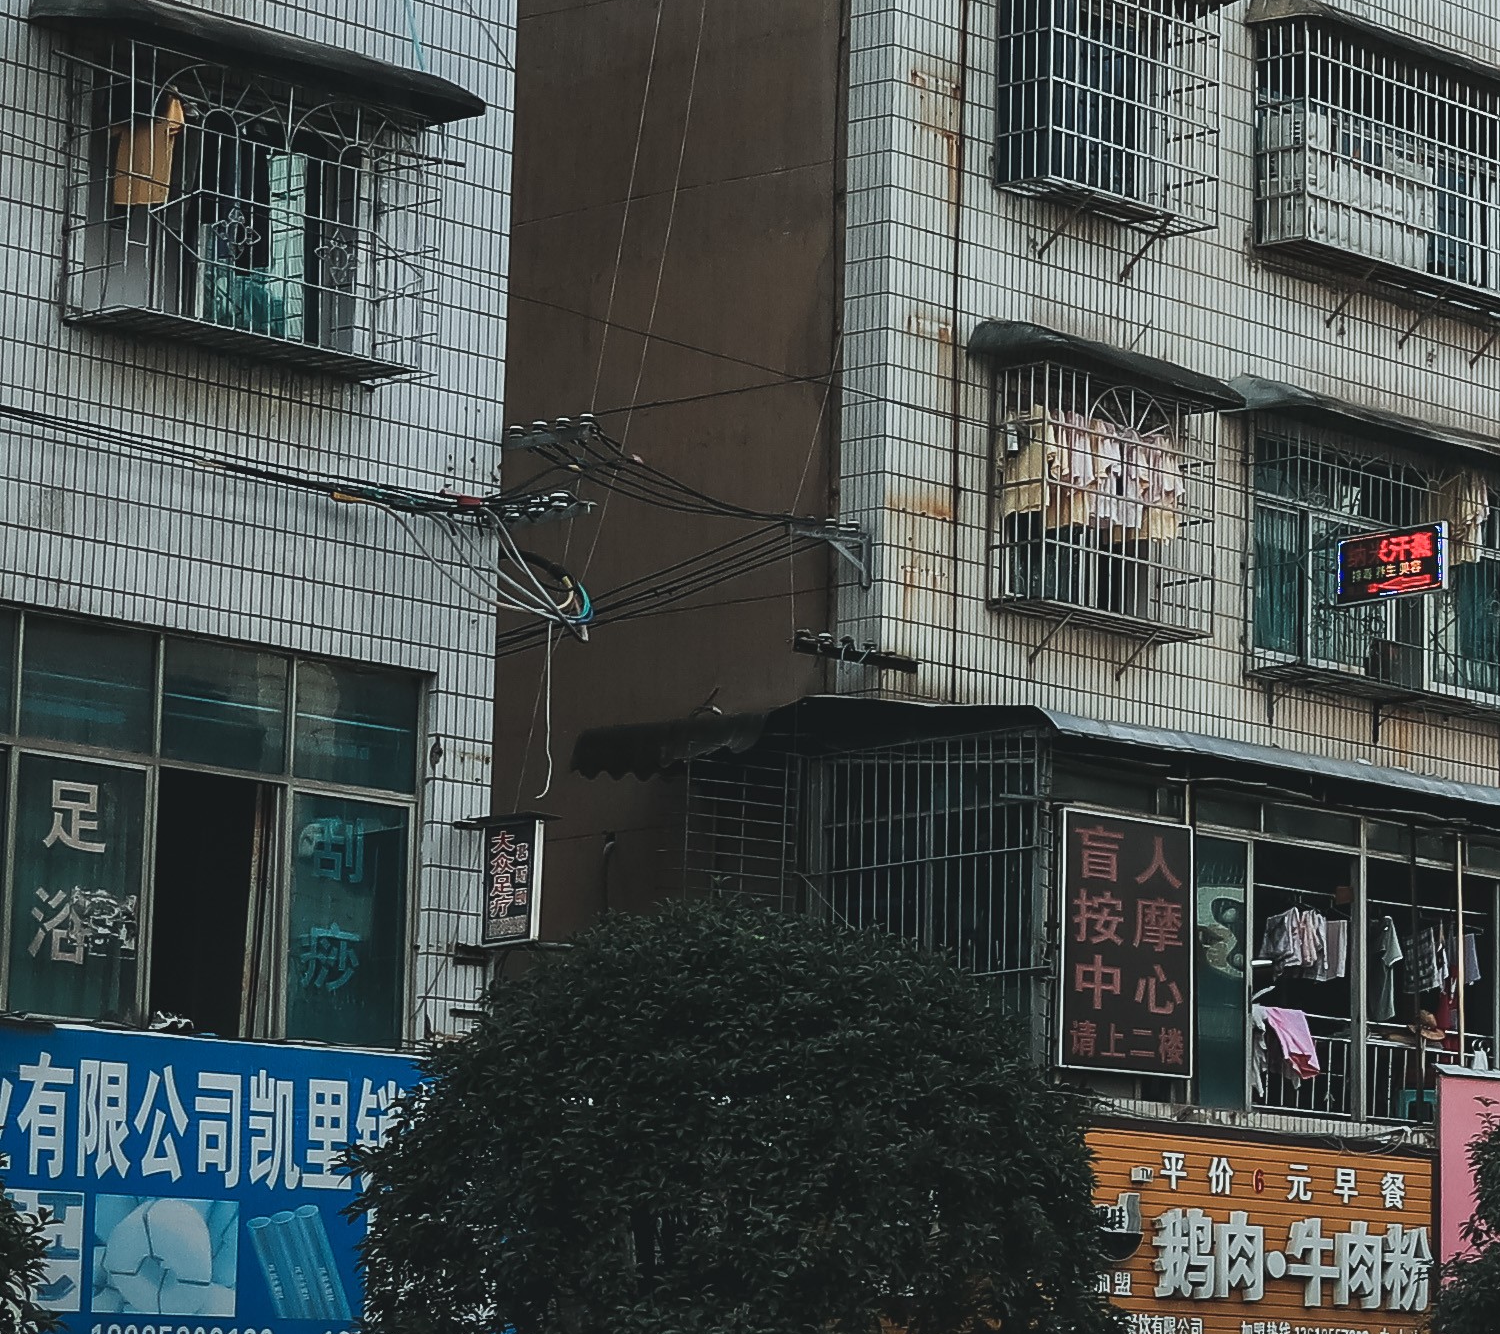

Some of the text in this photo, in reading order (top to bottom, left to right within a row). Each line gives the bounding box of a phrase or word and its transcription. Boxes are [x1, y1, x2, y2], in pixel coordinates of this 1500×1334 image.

[490, 830, 516, 918] 大众足疗
[1074, 825, 1184, 891] 盲人
[1072, 887, 1184, 953] 按摩
[1072, 953, 1184, 1018] 中心
[1070, 1018, 1186, 1068] 请上二楼
